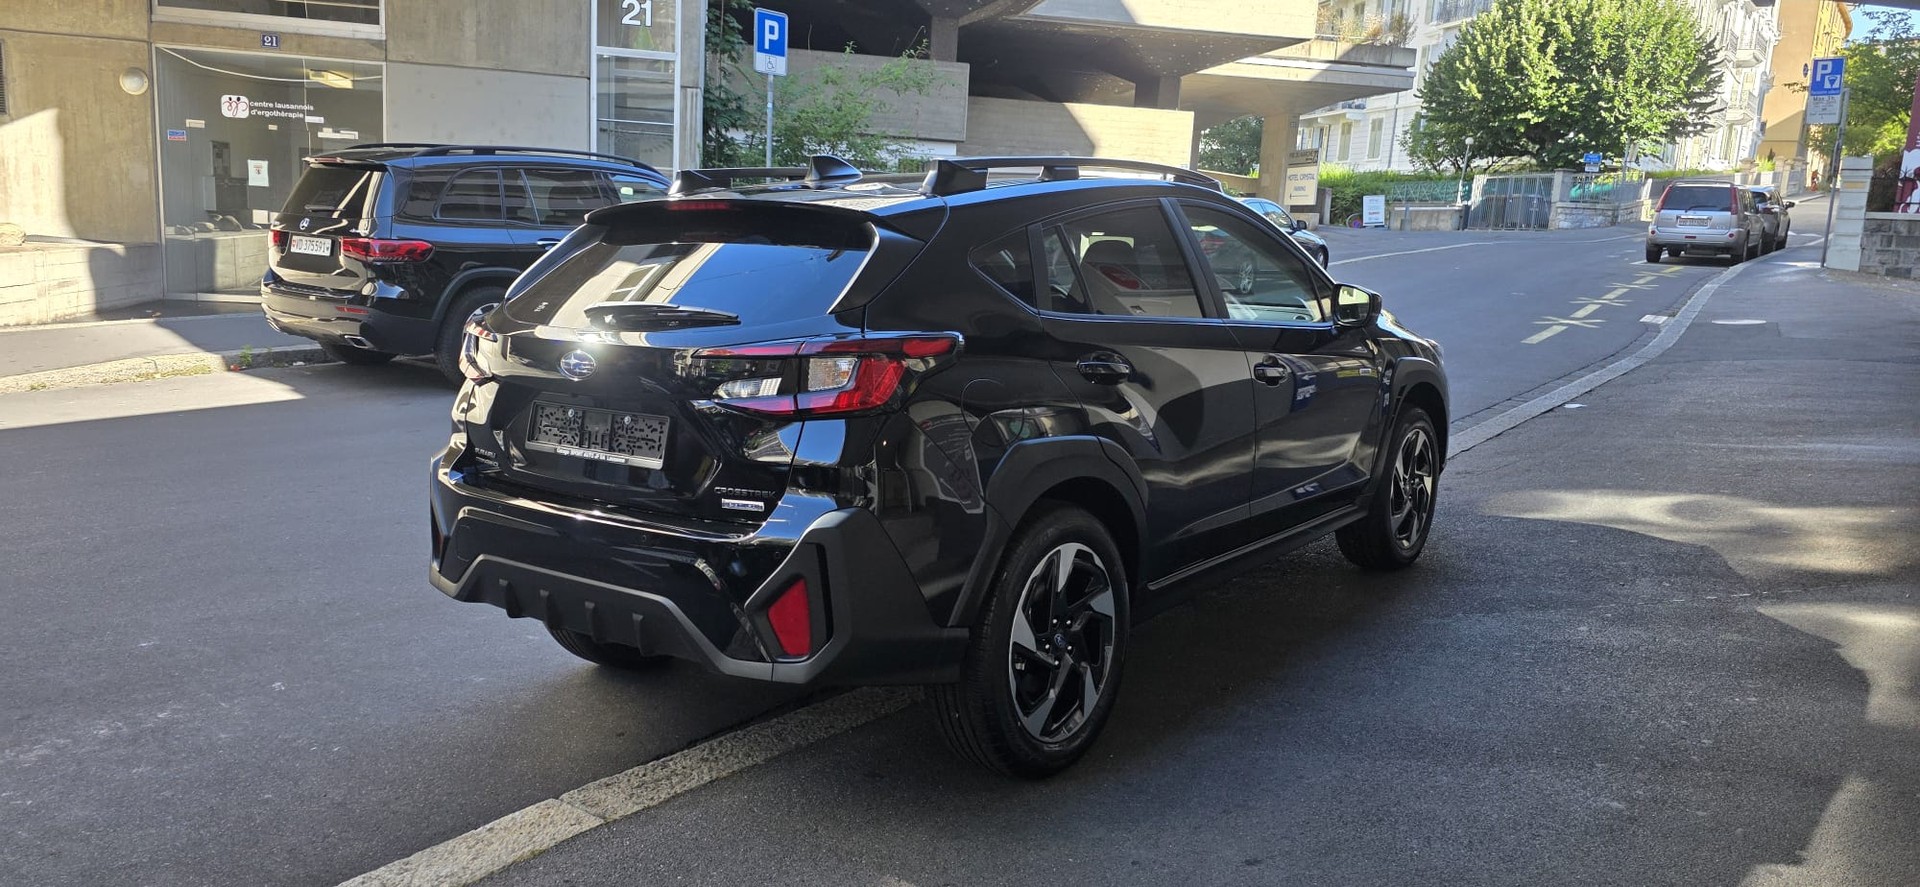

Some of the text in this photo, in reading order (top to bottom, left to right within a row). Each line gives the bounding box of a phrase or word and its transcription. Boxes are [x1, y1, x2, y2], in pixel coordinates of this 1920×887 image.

[621, 0, 652, 27] 21
[264, 35, 278, 47] 21
[764, 19, 779, 50] P
[1815, 61, 1833, 82] P
[249, 101, 314, 111] centre lausannois
[250, 109, 304, 119] d'ergothérapie
[713, 486, 777, 499] CROSSTREK
